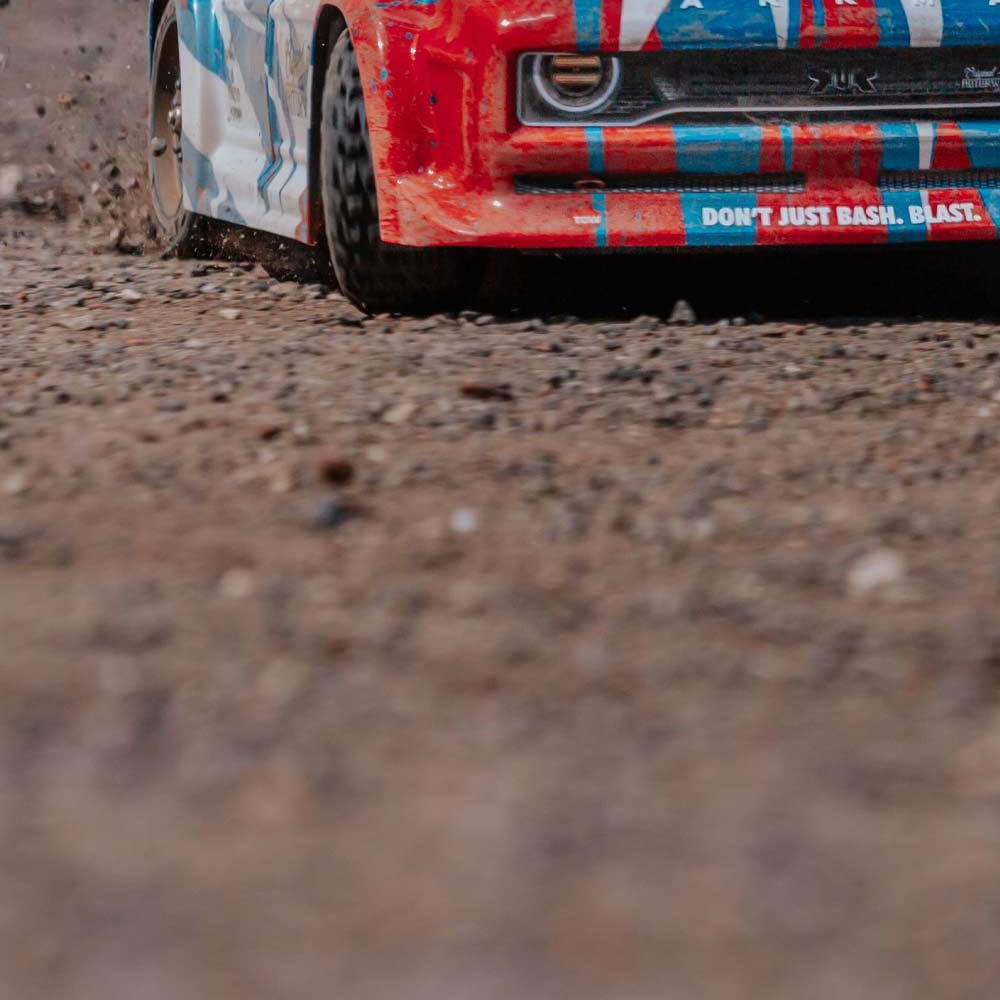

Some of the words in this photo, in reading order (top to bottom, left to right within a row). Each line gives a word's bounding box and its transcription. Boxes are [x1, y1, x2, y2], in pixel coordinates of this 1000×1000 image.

[702, 206, 773, 227] DON'T
[778, 205, 831, 226] JUST
[837, 204, 904, 226] BASH.
[908, 202, 982, 225] BLAST.
